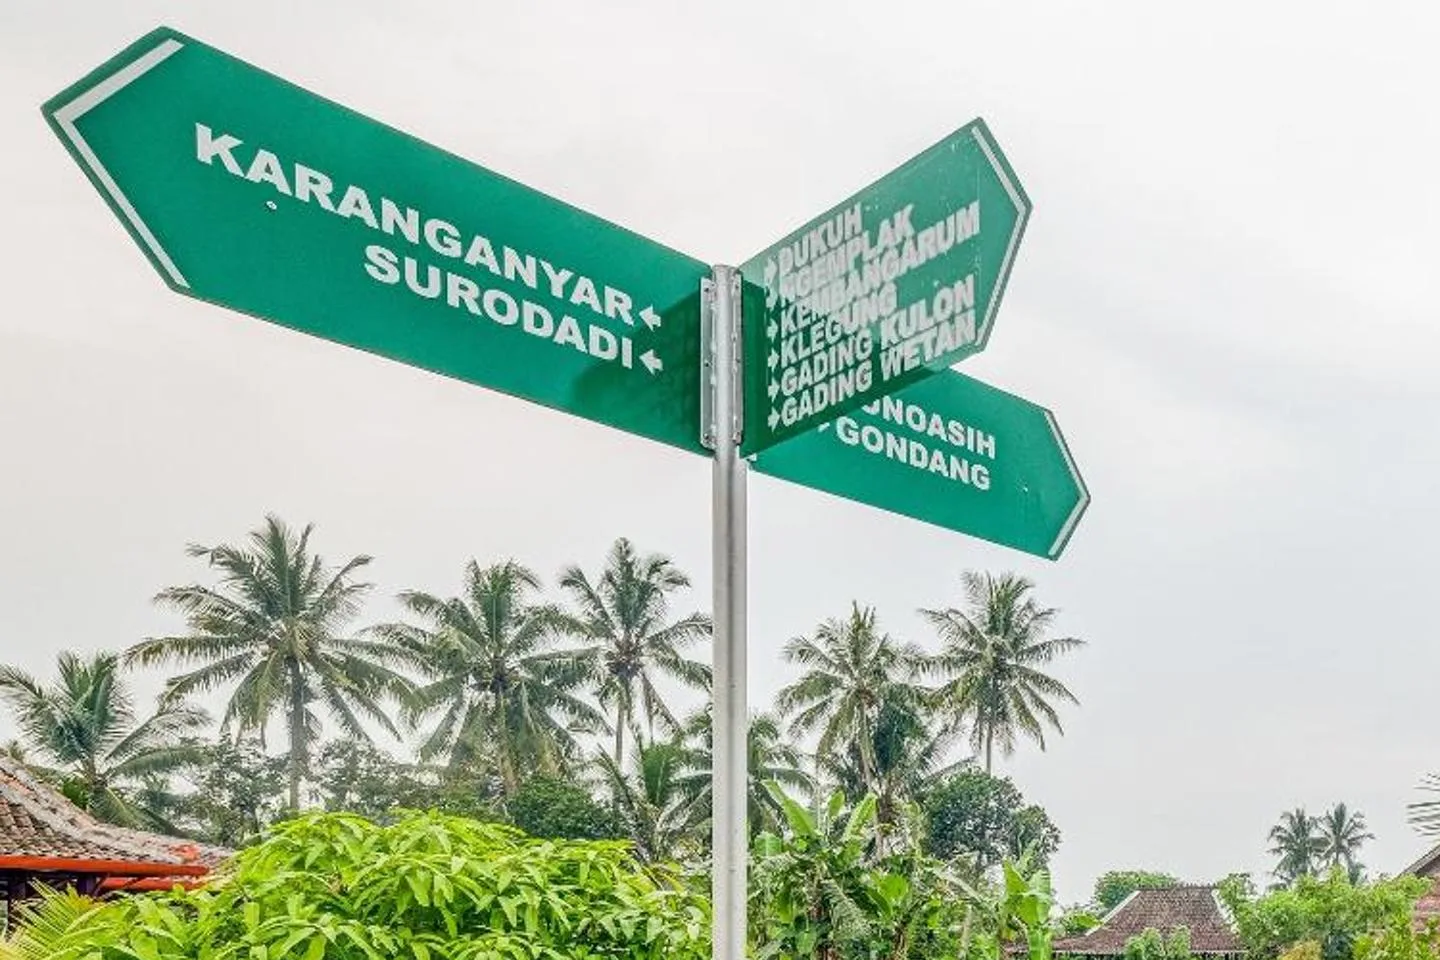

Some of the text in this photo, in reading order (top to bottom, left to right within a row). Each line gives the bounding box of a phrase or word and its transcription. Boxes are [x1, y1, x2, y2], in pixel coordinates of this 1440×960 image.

[195, 122, 635, 326] KARANGANYAR
[779, 202, 862, 273] DUKUH
[364, 245, 633, 369] SURODADI
[780, 282, 897, 368] KLEGUNG
[781, 274, 975, 396] GADING KULON
[781, 309, 976, 426] GADING WETAN
[836, 416, 990, 491] GONDANG
